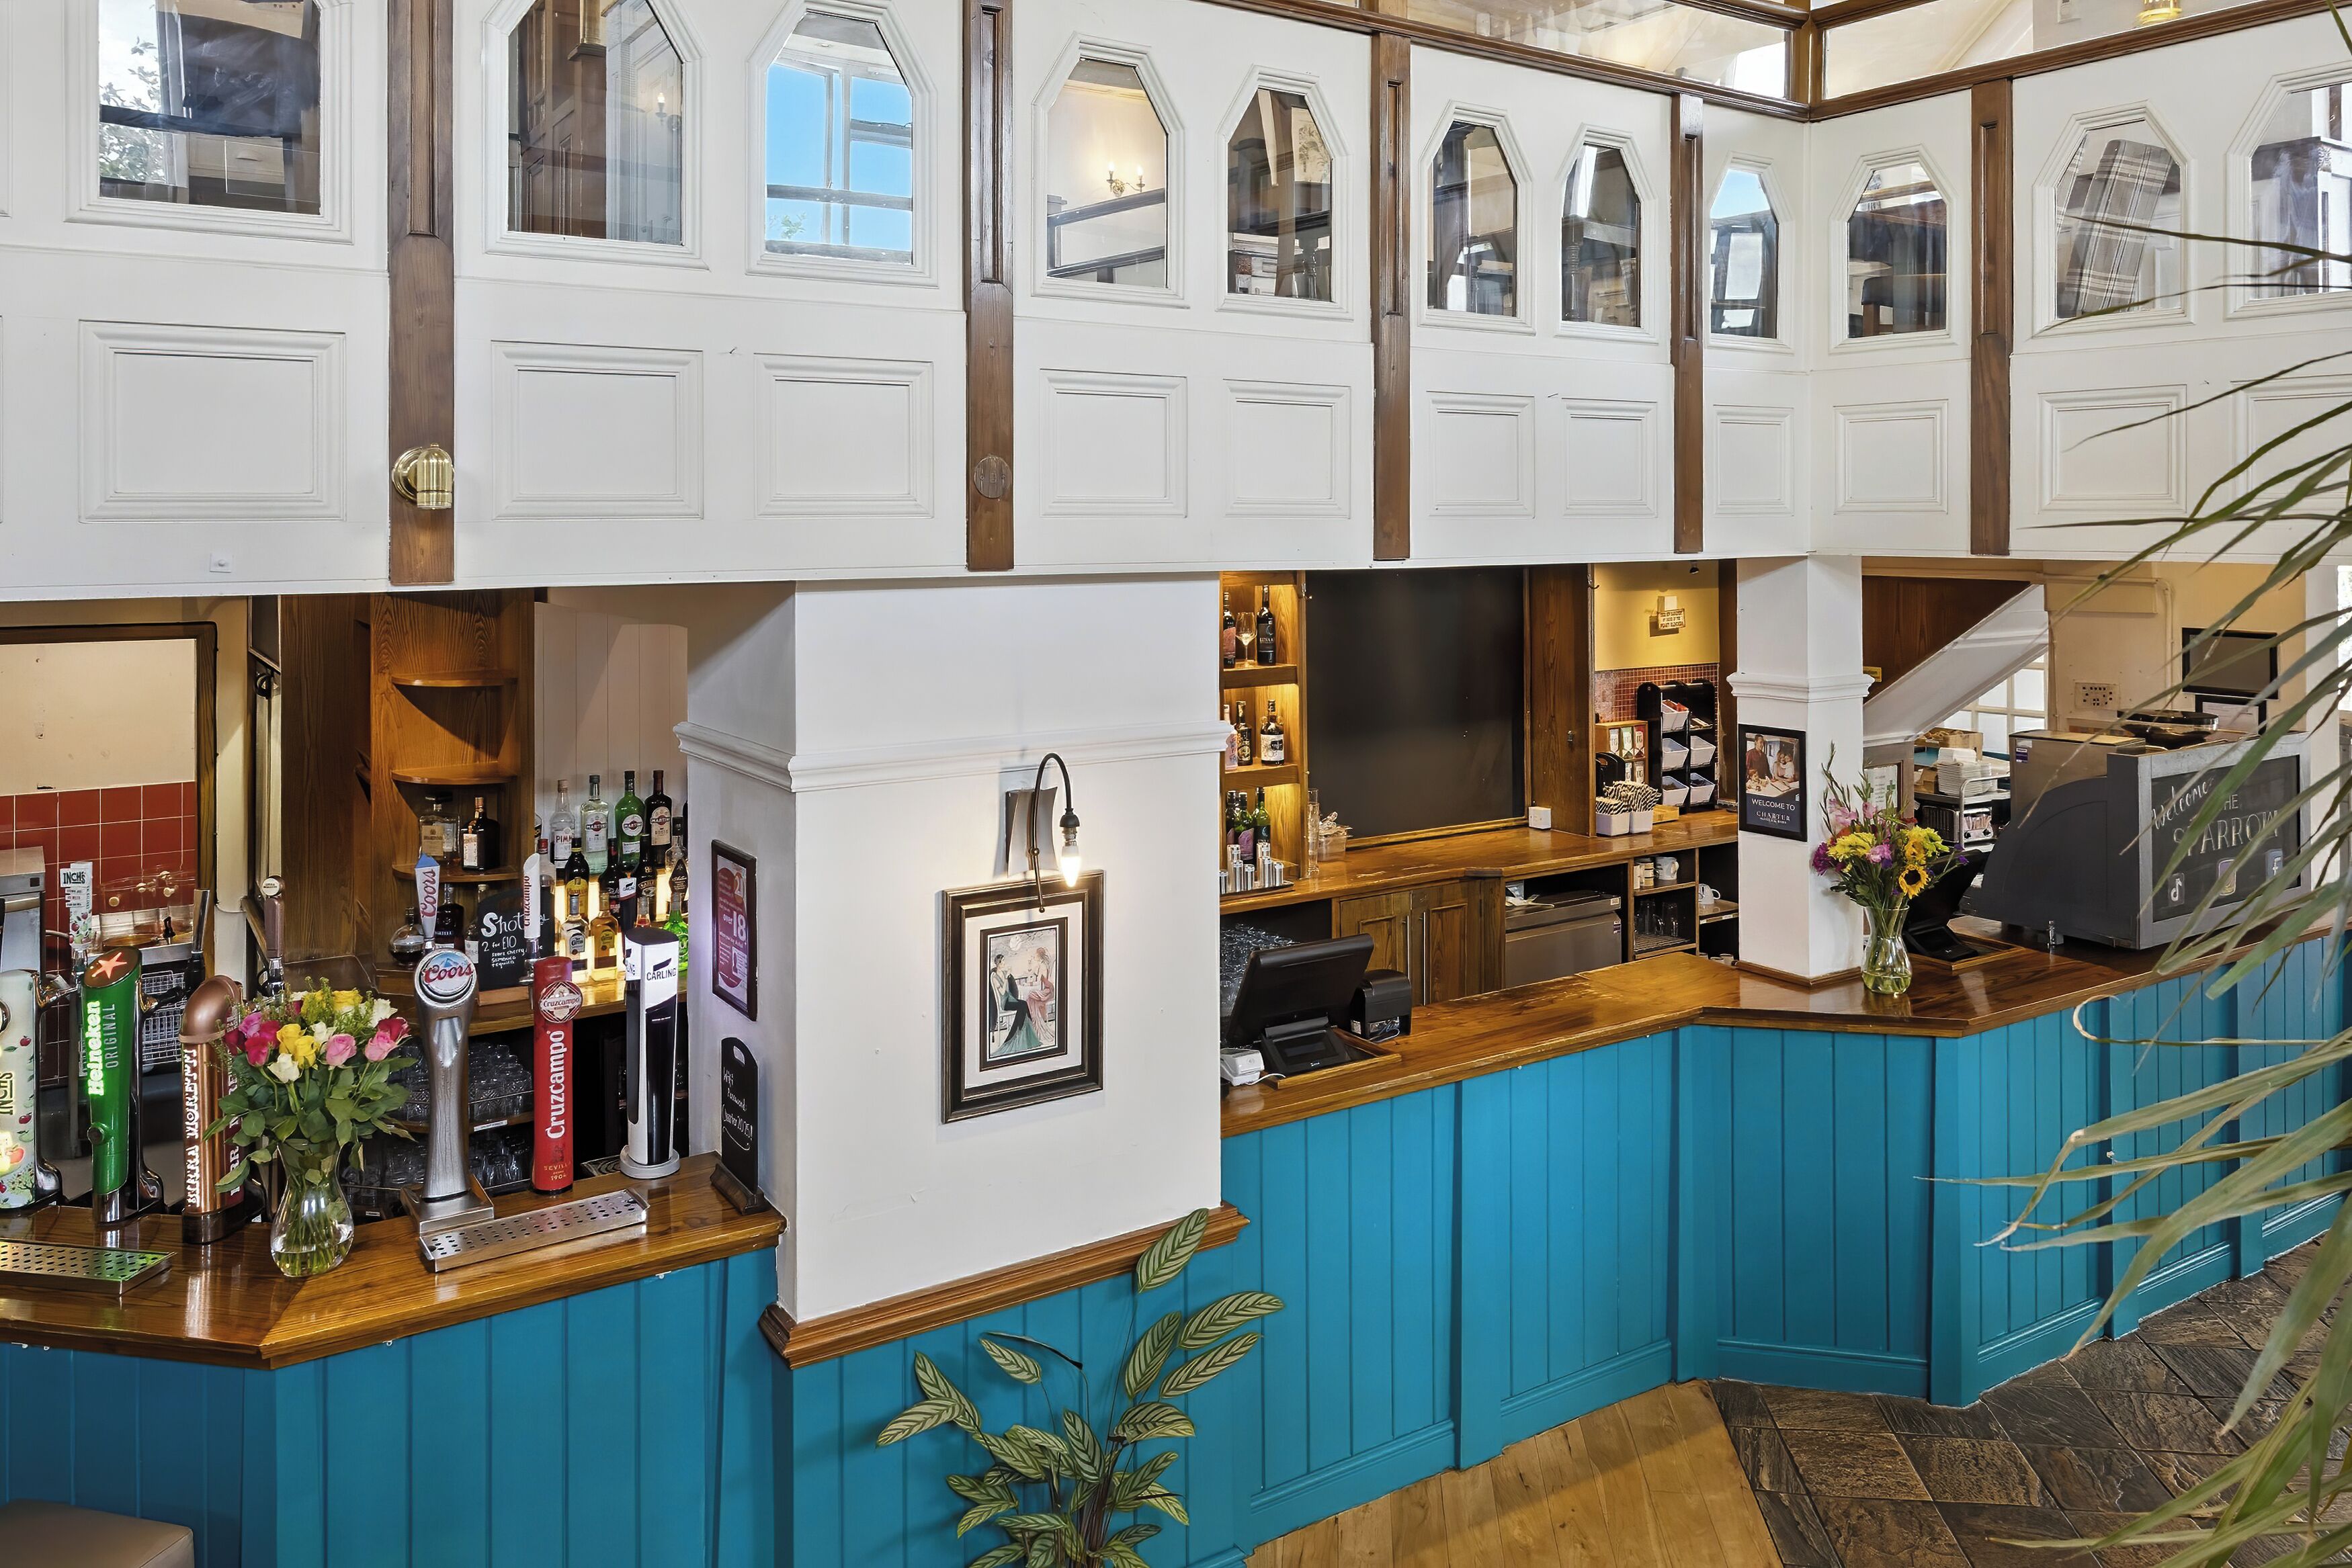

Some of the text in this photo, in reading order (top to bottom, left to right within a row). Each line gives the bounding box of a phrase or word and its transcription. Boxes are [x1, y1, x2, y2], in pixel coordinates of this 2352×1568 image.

[1751, 798, 1785, 810] WELCOME
[2223, 793, 2239, 811] HE
[1756, 811, 1790, 821] CHARTER
[2173, 810, 2279, 857] SARROW
[419, 869, 437, 918] Coors
[481, 941, 490, 952] 2
[421, 962, 474, 984] Coors
[646, 967, 677, 982] CARLING
[543, 997, 580, 1008] Cruzcampo
[103, 1004, 119, 1068] ORIGINAL
[85, 1000, 104, 1096] Heineken
[183, 1049, 200, 1139] MORETTI
[546, 1030, 567, 1139] Cruzcampo
